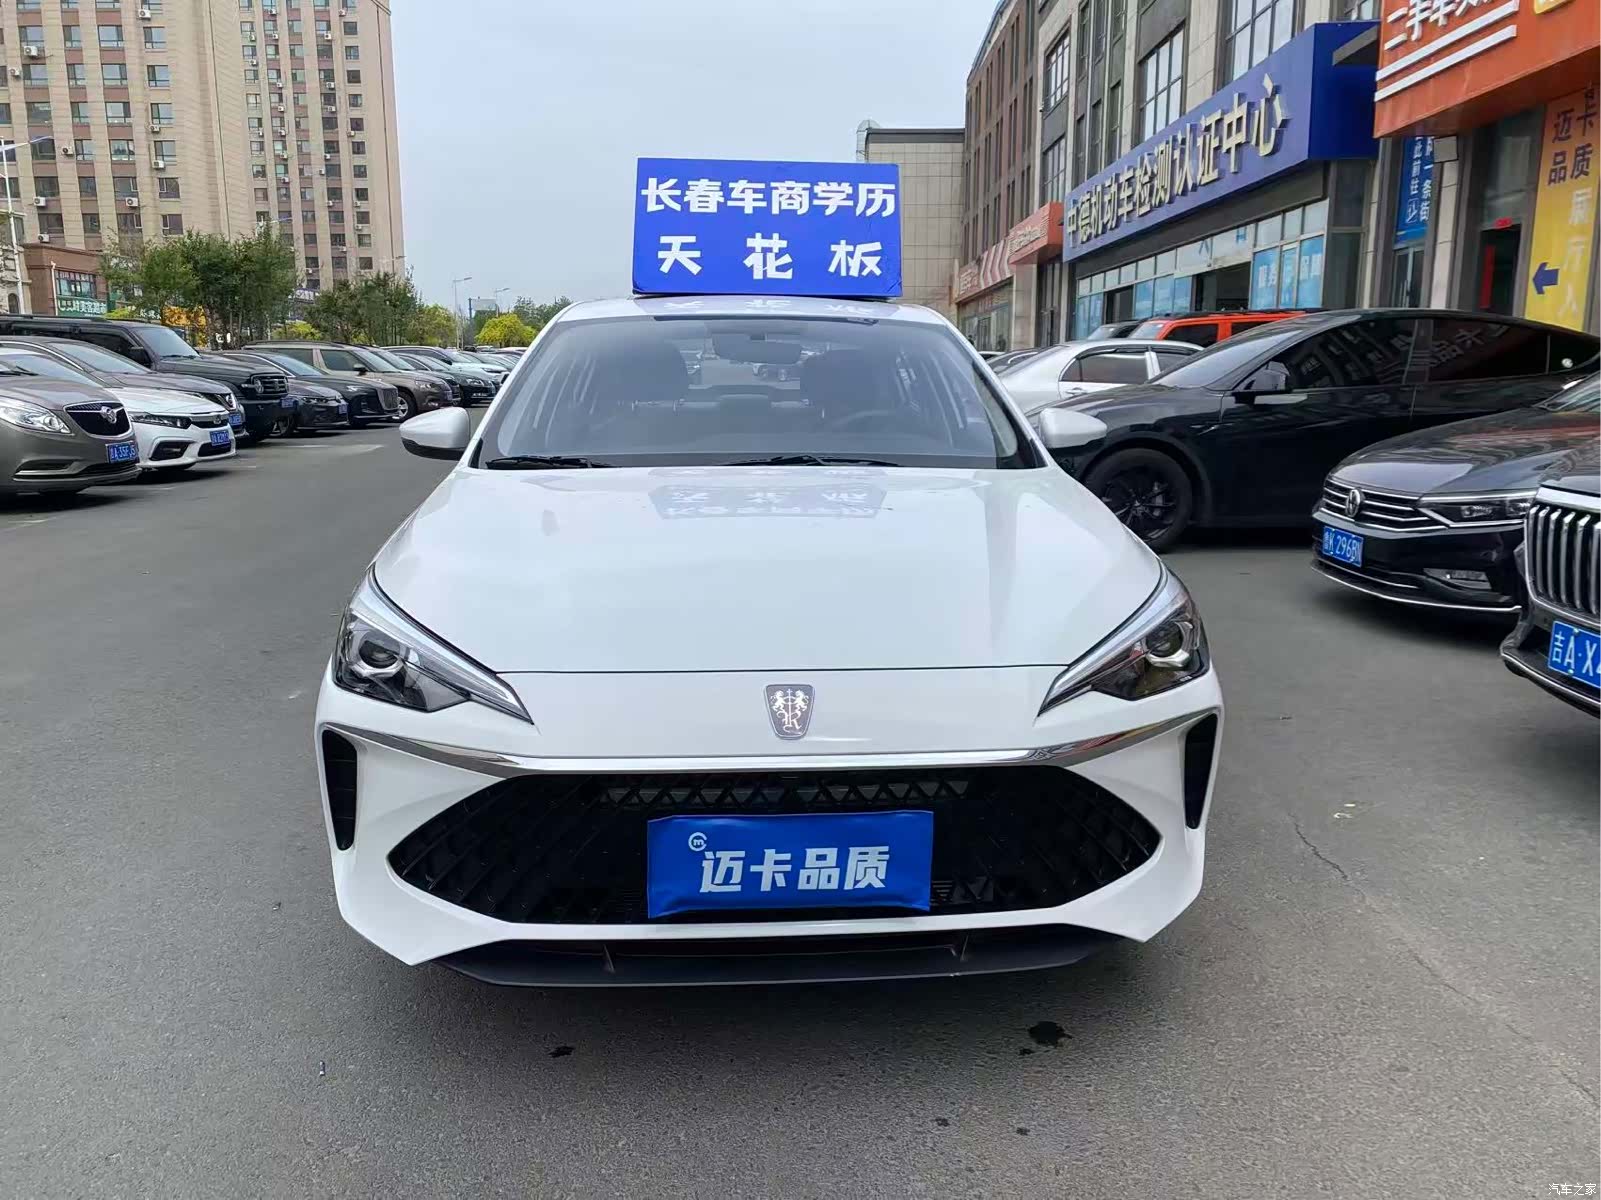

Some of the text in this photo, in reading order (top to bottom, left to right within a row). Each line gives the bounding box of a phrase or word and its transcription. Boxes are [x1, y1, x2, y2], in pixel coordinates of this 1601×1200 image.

[1067, 72, 1291, 248] 中德机动车检测认证中心
[641, 178, 896, 217] 长春车商学历
[658, 233, 882, 280] 天花板
[699, 845, 890, 893] 迈卡品质
